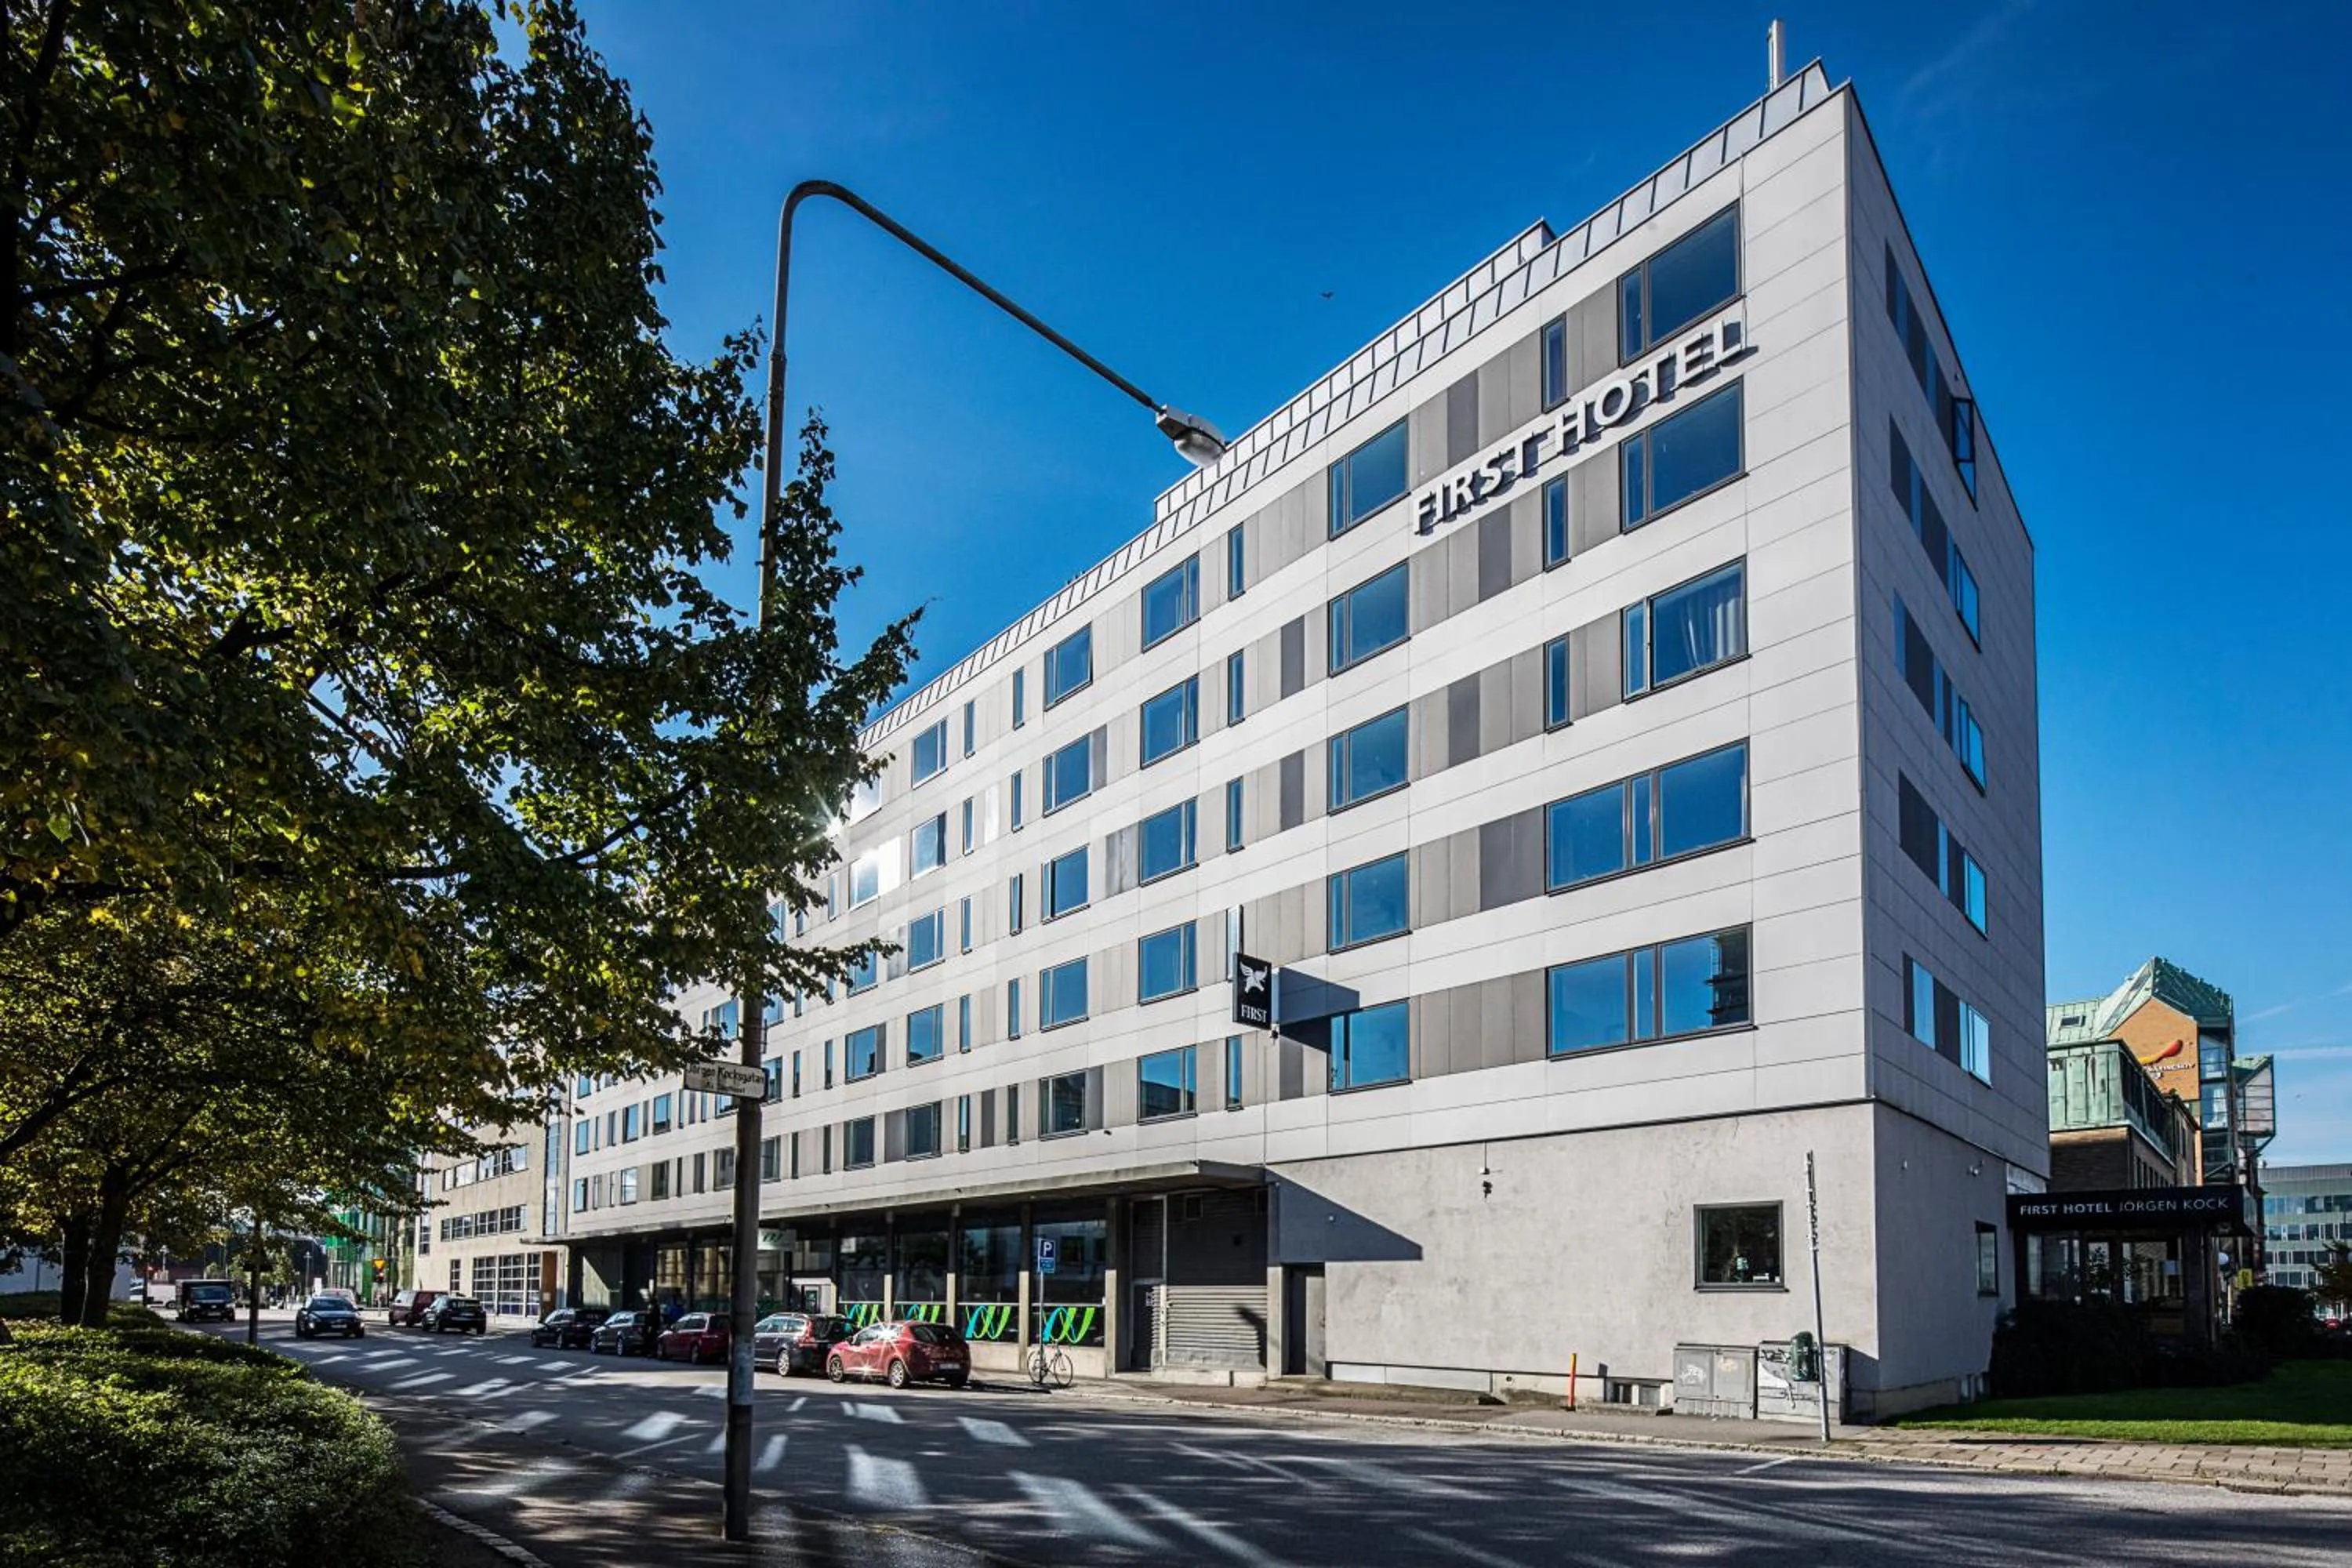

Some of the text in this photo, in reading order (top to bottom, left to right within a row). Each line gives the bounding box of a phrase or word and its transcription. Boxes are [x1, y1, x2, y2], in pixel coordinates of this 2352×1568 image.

[1414, 318, 1749, 535] FIRST HOTEL
[1240, 1004, 1268, 1023] FIRST
[2020, 1203, 2058, 1215] FIRST
[2063, 1202, 2113, 1214] HOTEL
[2183, 1196, 2229, 1210] KOCK
[1044, 1241, 1052, 1256] P
